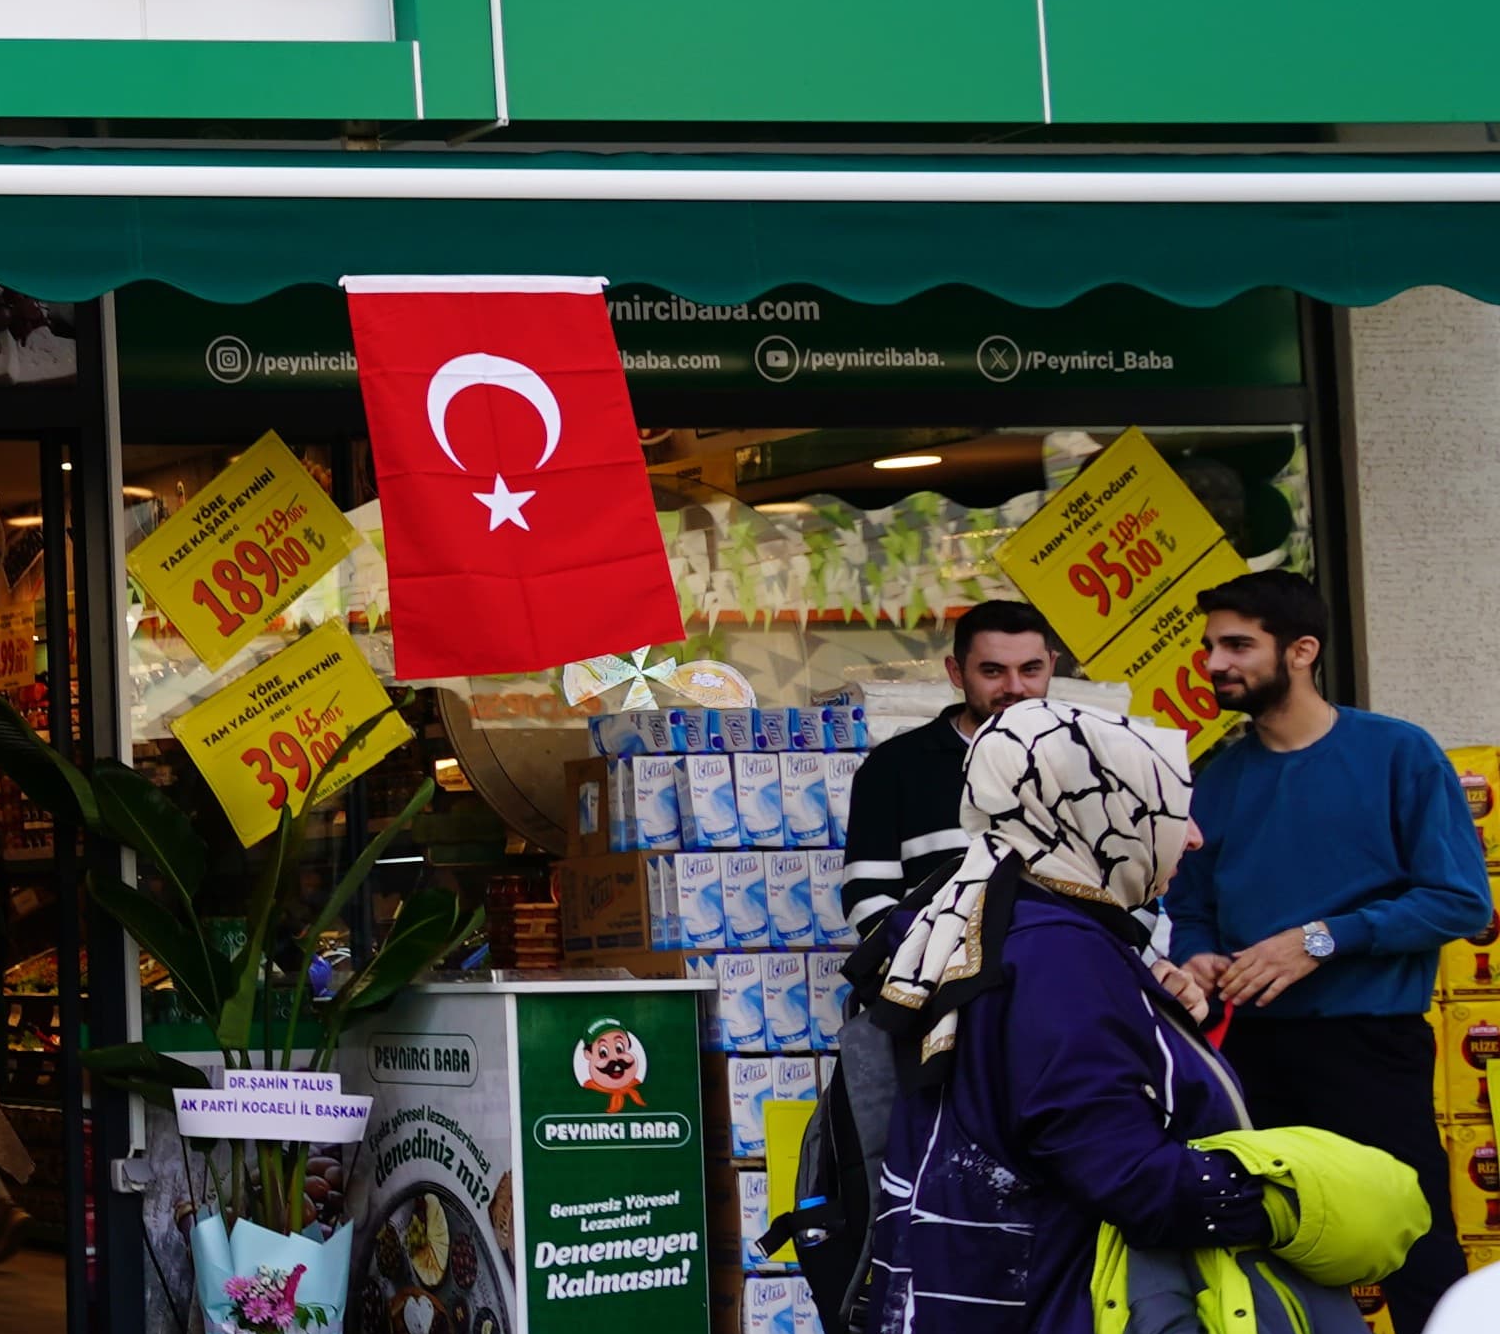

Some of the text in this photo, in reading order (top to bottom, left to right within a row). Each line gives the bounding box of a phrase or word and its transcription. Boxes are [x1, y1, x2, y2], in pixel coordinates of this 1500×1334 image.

[160, 467, 276, 572] TAZE KAŞAR PEYNİRİ
[192, 494, 227, 526] YÖRE
[1030, 465, 1139, 566] YARIM YAĞLI YOĞURT
[1061, 491, 1093, 520] YÖRE
[1151, 605, 1184, 636] YÖRE
[1124, 617, 1190, 679] TAZE BEYAZ
[202, 651, 343, 749] TAM YAĞLI KREM PEYNİR
[248, 675, 283, 702] YÖRE
[434, 1049, 470, 1073] BABA
[292, 1078, 333, 1092] TALUS
[181, 1098, 368, 1119] AK PARTİ KOCAELİ İL BAŞKANI
[630, 1121, 680, 1140] BABA
[457, 1159, 490, 1210] mi?
[550, 1190, 680, 1218] Benzersiz Yöresel
[580, 1212, 651, 1233] Lezzetleri
[534, 1230, 699, 1269] Denemeyen
[546, 1259, 692, 1300] Kalmasın!
